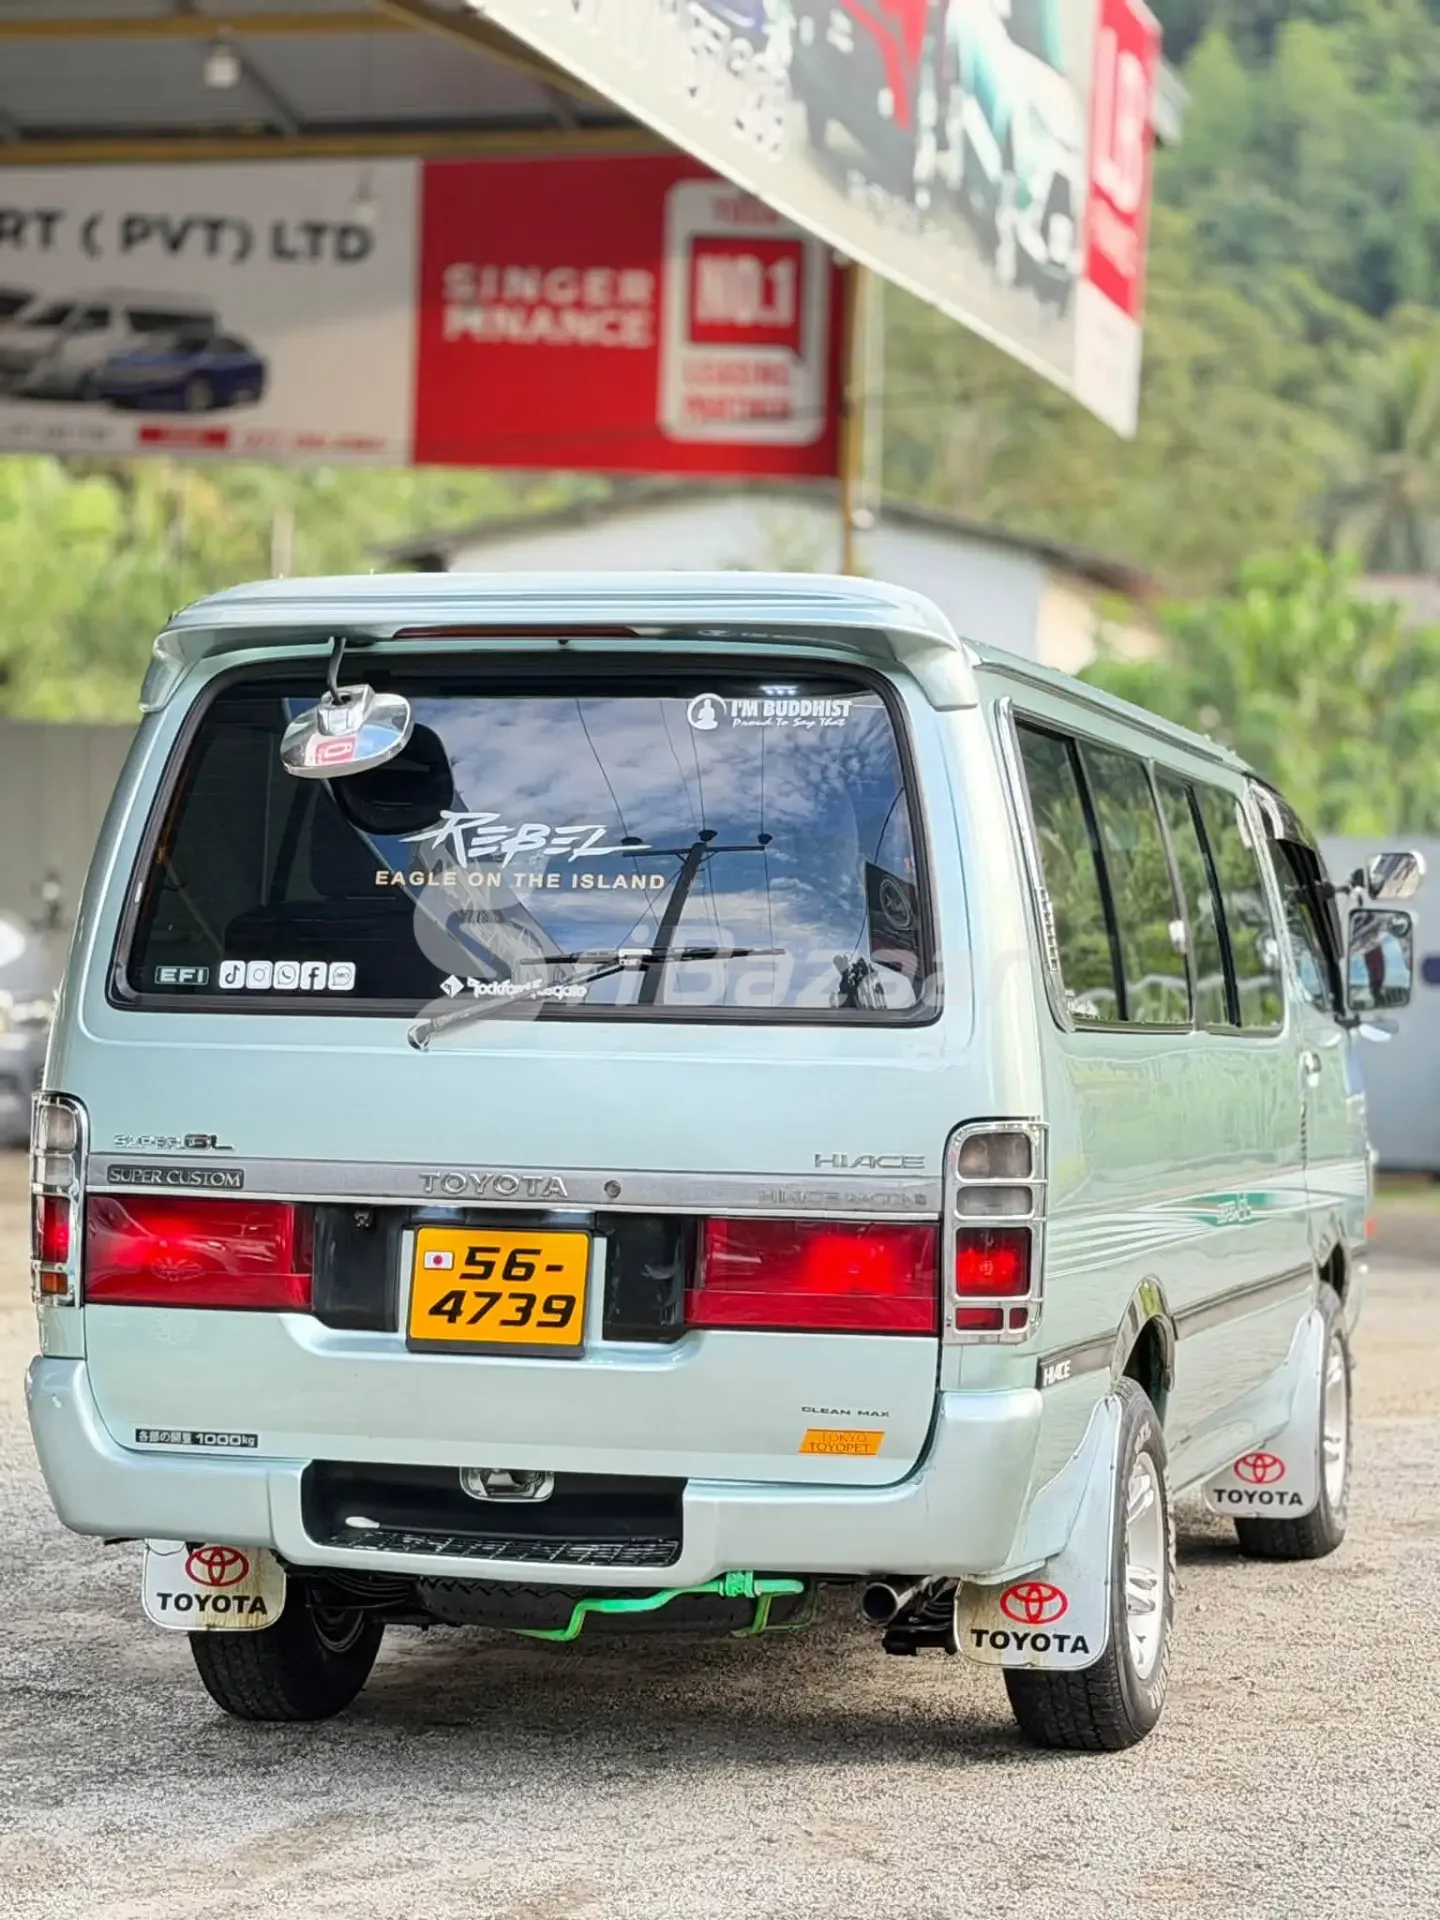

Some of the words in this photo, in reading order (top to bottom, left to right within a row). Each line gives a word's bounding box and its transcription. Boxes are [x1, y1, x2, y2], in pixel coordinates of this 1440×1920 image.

[271, 219, 373, 263] LTD
[442, 262, 655, 307] SINGER
[731, 700, 759, 717] I'M
[763, 700, 852, 718] BUDDHIST
[732, 717, 773, 729] Proud
[775, 718, 790, 727] To
[792, 717, 817, 729] Say
[818, 717, 847, 728] That
[374, 870, 463, 887] EAGLE
[467, 872, 502, 888] ON
[513, 872, 562, 889] THE
[571, 873, 666, 890] ISLAND
[159, 968, 205, 983] EFI
[814, 1153, 926, 1170] HIACE
[109, 1168, 163, 1184] SUPER
[166, 1170, 241, 1187] CUSTOM
[419, 1172, 568, 1198] TOYOTA
[459, 1246, 565, 1281] 56-
[428, 1289, 577, 1329] 4739
[801, 1406, 851, 1416] CLEAN
[857, 1410, 890, 1418] MAX
[196, 1433, 256, 1447] 1000kg
[822, 1432, 867, 1443] TOKYO
[808, 1441, 871, 1453] TOYOPET
[1213, 1488, 1304, 1506] TOYOTA
[156, 1592, 267, 1615] TOYOTA
[971, 1628, 1090, 1654] TOYOTA
